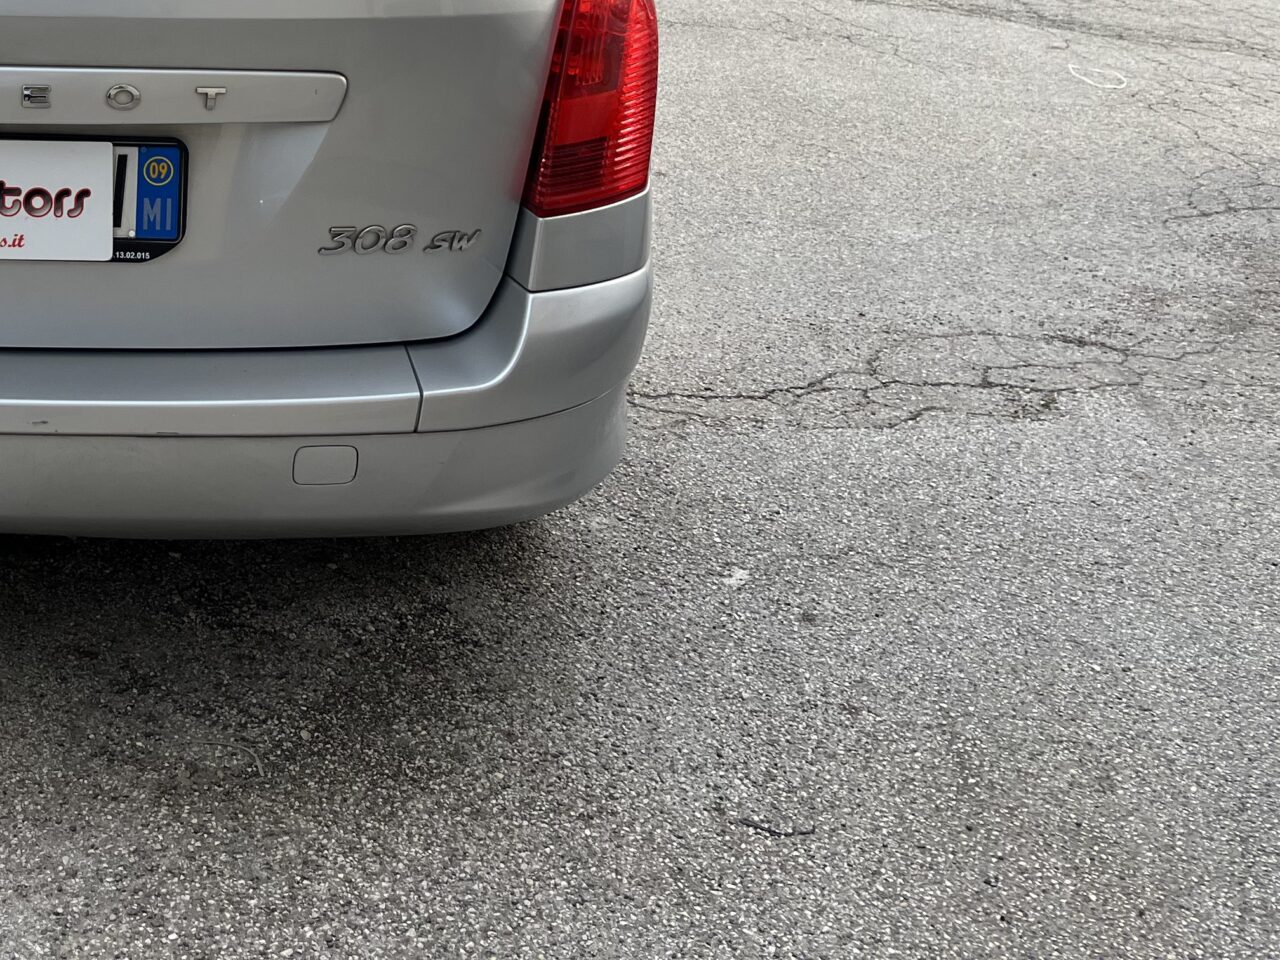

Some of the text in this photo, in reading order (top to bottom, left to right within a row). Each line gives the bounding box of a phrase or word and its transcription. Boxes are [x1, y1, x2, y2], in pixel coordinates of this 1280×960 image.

[149, 162, 168, 179] 09
[142, 198, 172, 231] MI
[318, 224, 482, 255] 308 SW
